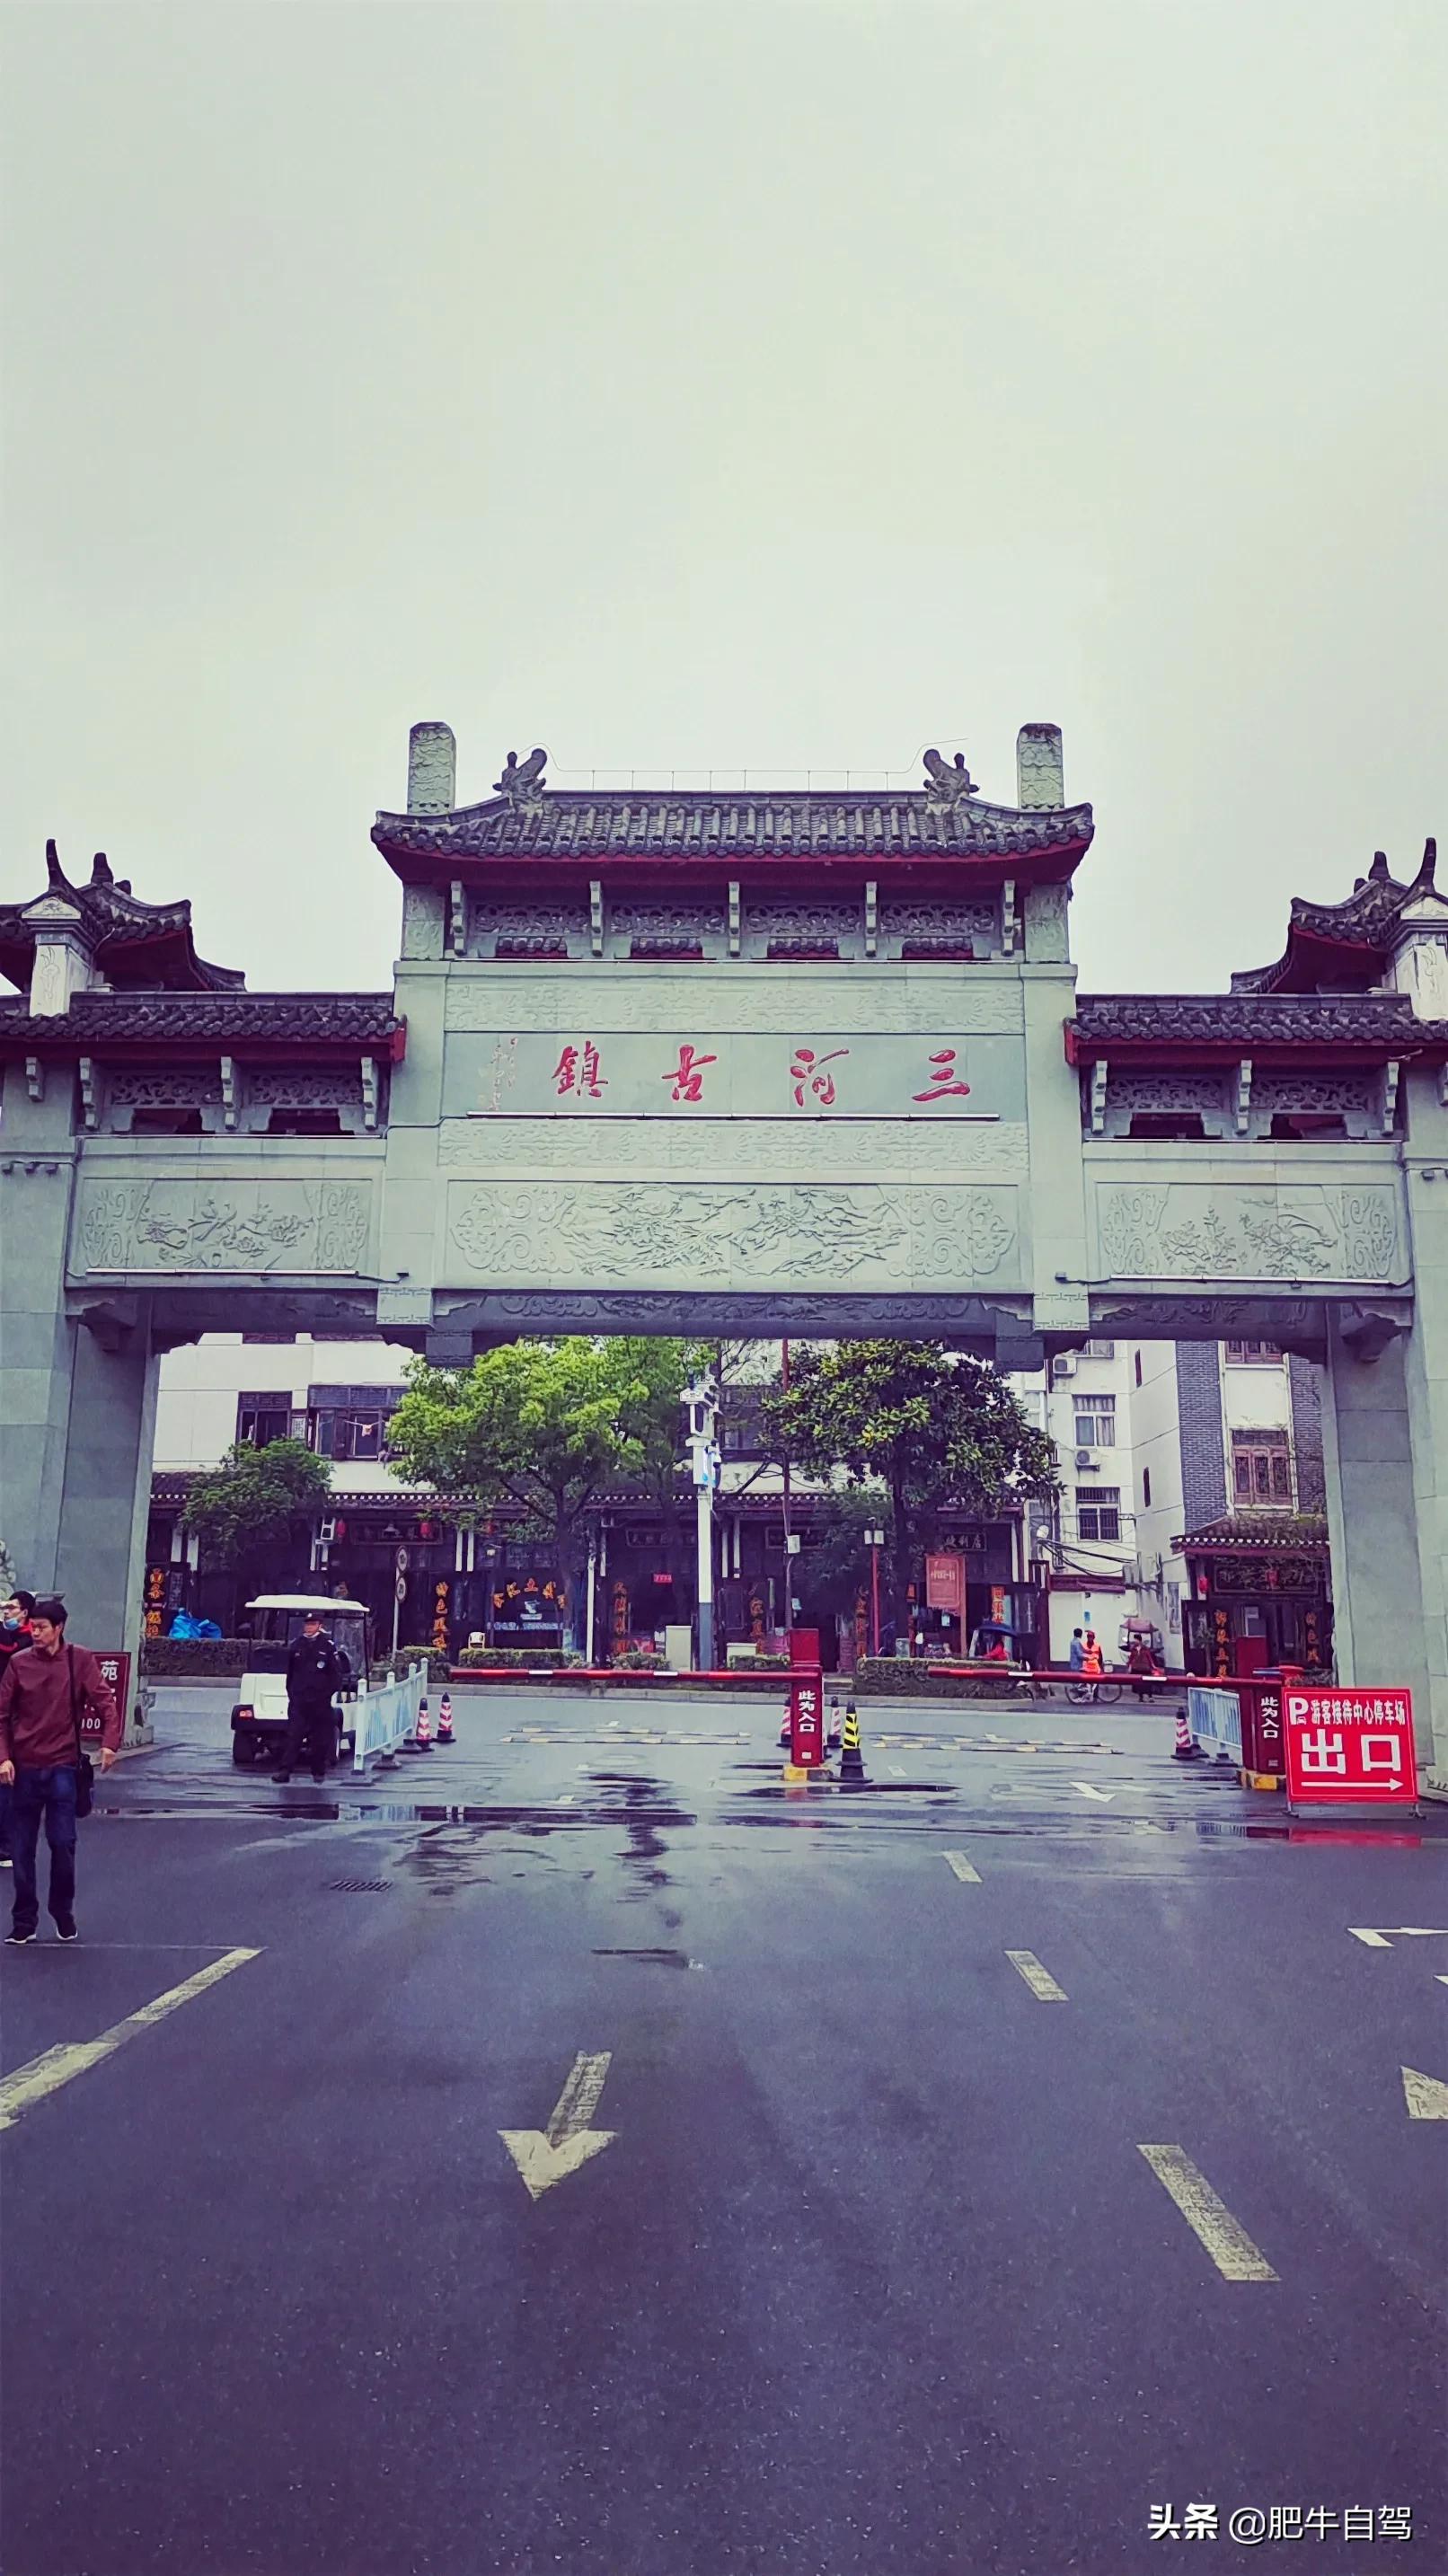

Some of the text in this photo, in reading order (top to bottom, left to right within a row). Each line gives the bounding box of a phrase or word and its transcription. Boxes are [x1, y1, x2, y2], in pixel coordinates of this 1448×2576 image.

[798, 1689, 817, 1733] 此为入口
[1260, 1696, 1279, 1739] 此为入口
[1311, 1698, 1406, 1726] 游客接待中心停车场
[1301, 1729, 1402, 1775] 出口
